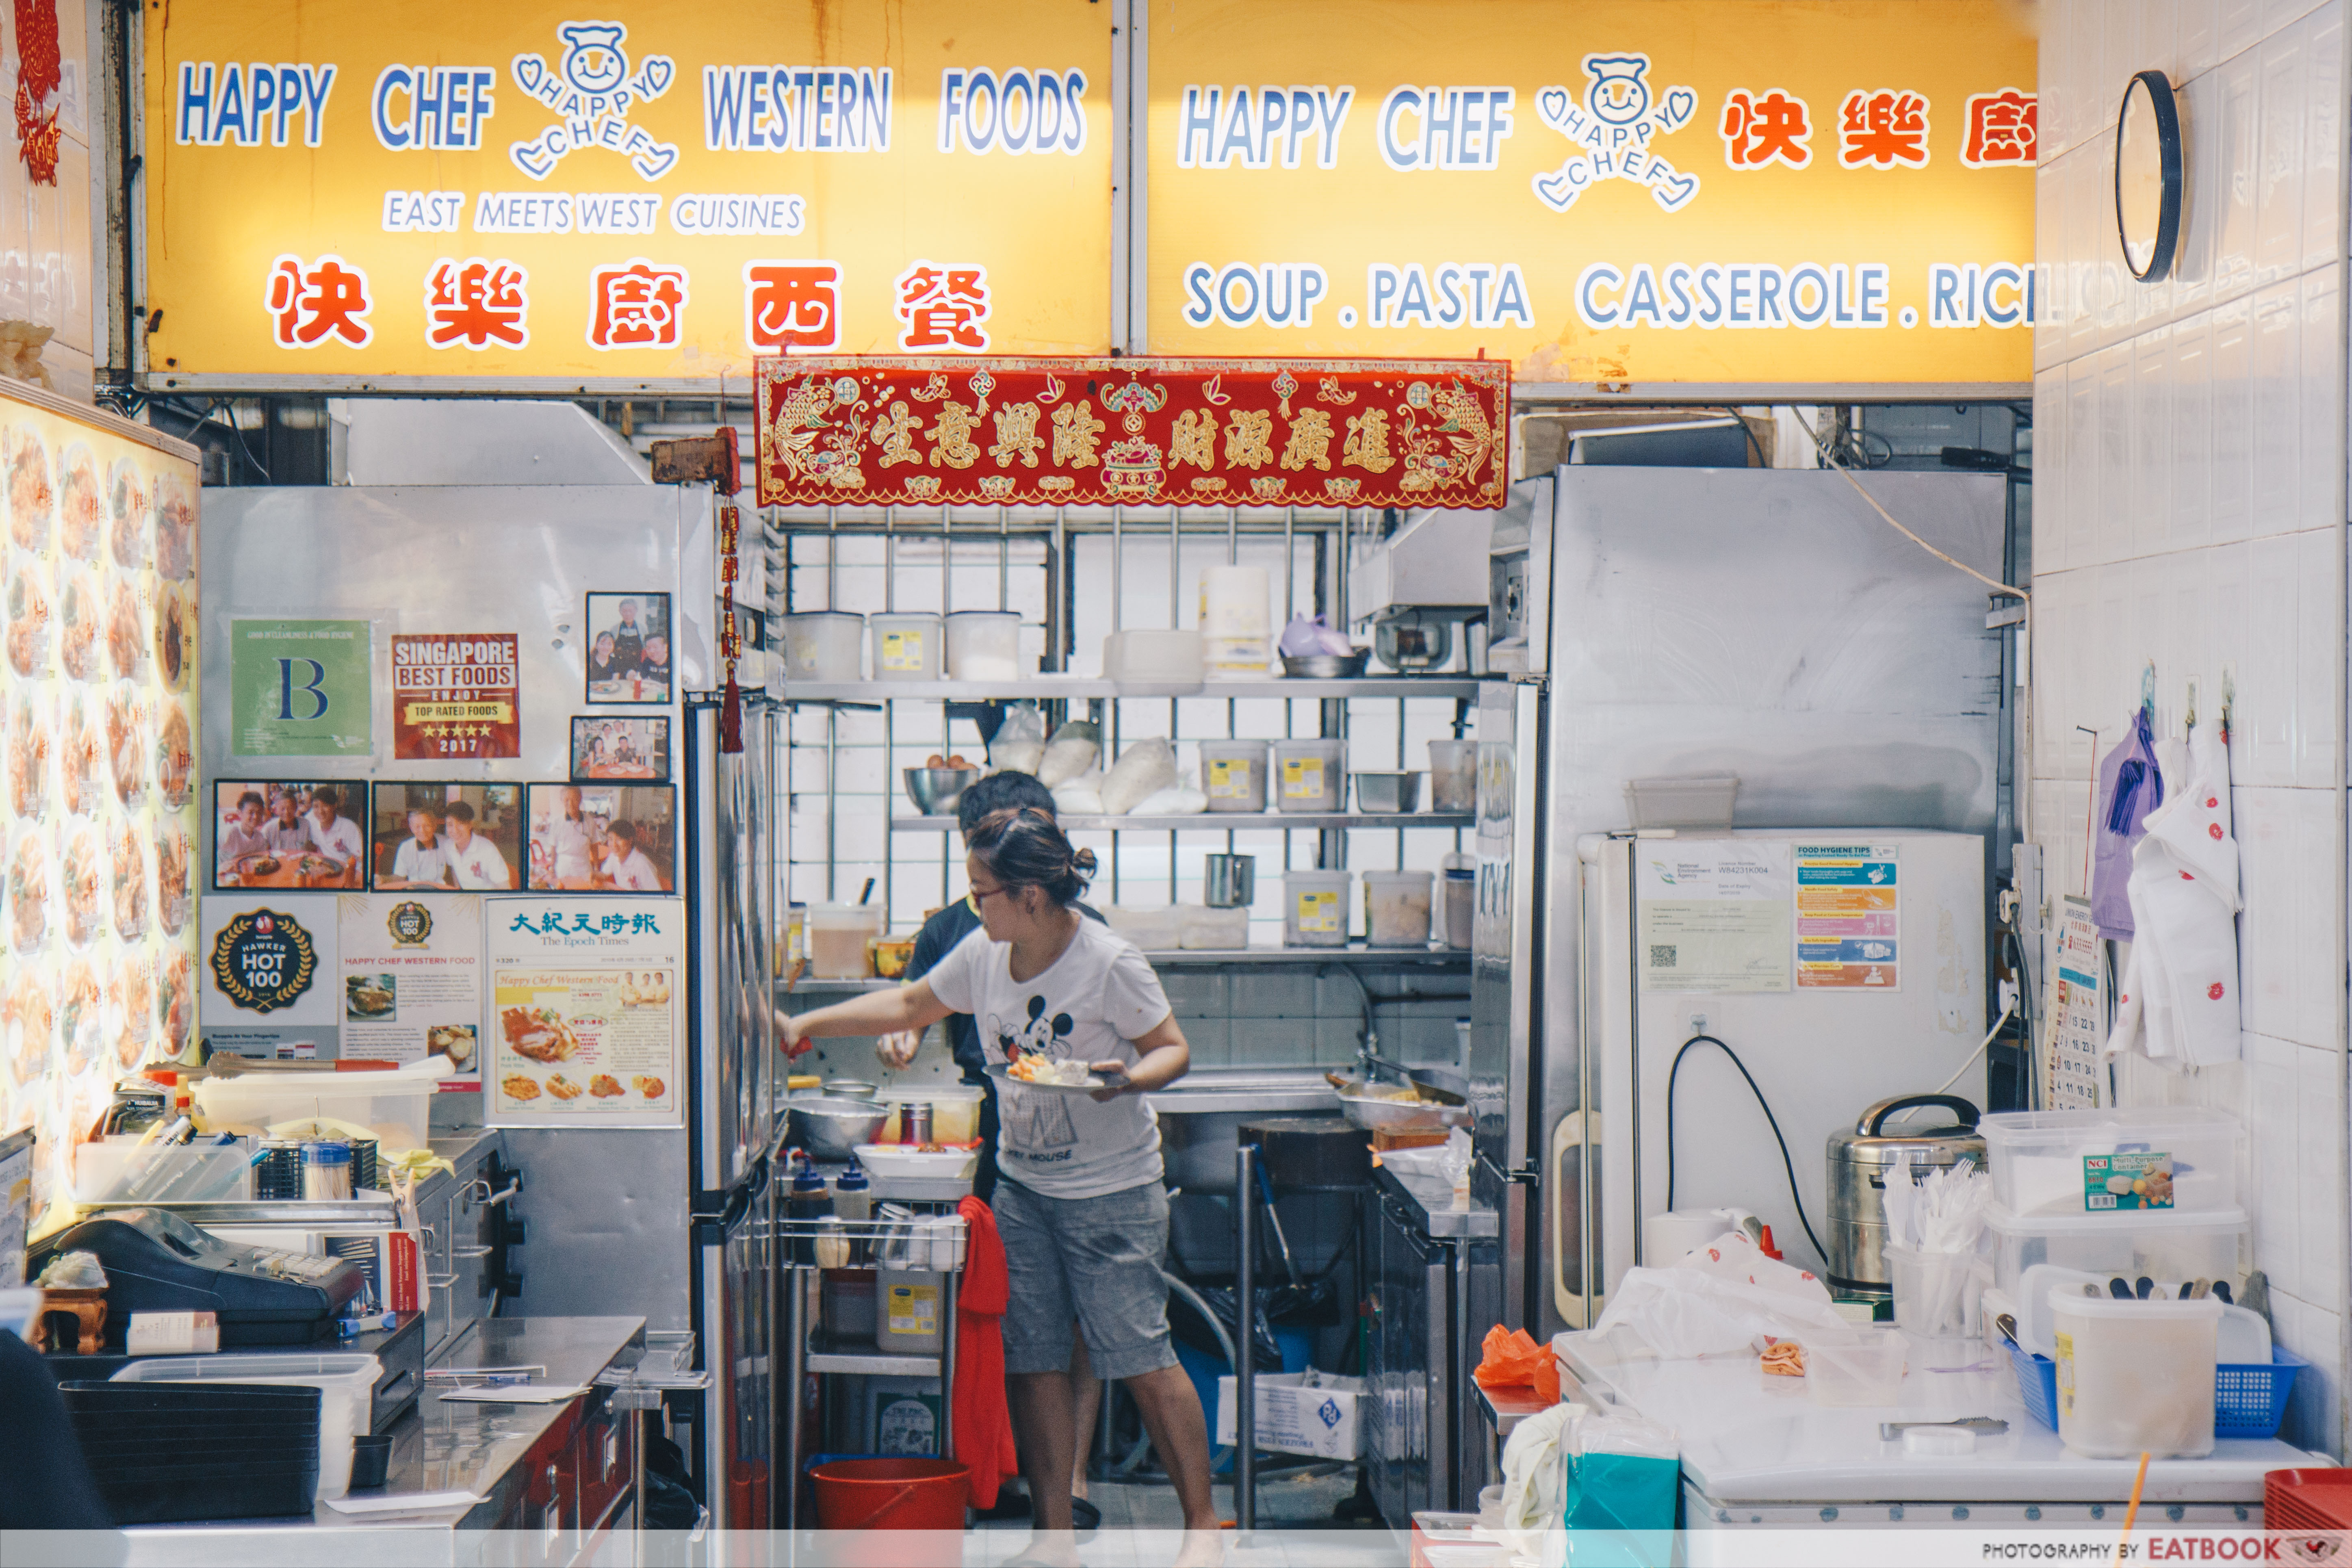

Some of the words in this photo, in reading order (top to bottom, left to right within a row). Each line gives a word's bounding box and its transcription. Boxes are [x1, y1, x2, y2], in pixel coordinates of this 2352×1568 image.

[182, 65, 333, 145] HAPPY
[376, 70, 492, 146] CHEF
[542, 76, 652, 118] HAPPY
[708, 70, 889, 147] WESTERN
[944, 72, 1085, 150] FOODS
[1184, 90, 1351, 163] HAPPY
[1384, 90, 1511, 165] CHEF
[1564, 106, 1672, 148] HAPPY
[545, 119, 646, 154] CHEF
[1567, 150, 1667, 185] CHEF
[387, 197, 461, 227] EAST
[479, 197, 570, 228] MEETS
[581, 198, 658, 228] WEST
[676, 200, 800, 229] CUISINES
[1187, 267, 1322, 322] SOUP
[1375, 269, 1528, 322] PASTA
[1582, 268, 1888, 323] CASSEROLE
[1935, 268, 2035, 323] RIC
[1168, 406, 1397, 474] 財源廣進
[396, 642, 515, 665] SINGAPORE
[399, 668, 445, 686] BEST
[451, 668, 511, 686] FOODS
[274, 657, 329, 720] B
[431, 690, 481, 702] ENJOY
[415, 707, 432, 717] TOP
[435, 707, 463, 717] RATED
[467, 706, 498, 716] FOODS
[440, 740, 477, 752] 2017
[509, 913, 661, 935] 大紀元時報
[241, 942, 286, 952] HAWKER
[541, 937, 561, 946] The
[564, 937, 595, 947] Epoch
[597, 936, 629, 946] Times
[241, 954, 286, 970] HOT
[345, 957, 375, 965] HAPPY
[378, 957, 402, 965] CHEF
[246, 971, 282, 987] 100
[500, 976, 530, 987] Happy
[532, 975, 553, 987] Chef
[556, 975, 594, 985] Western
[596, 975, 620, 984] Food
[2081, 1018, 2088, 1029] 22
[2072, 1039, 2079, 1050] 16
[2082, 1041, 2090, 1052] 23
[2064, 1060, 2071, 1071] 10
[2075, 1062, 2081, 1073] 17
[2085, 1064, 2091, 1075] 24
[2066, 1082, 2073, 1093] 11
[2077, 1084, 2084, 1096] 18
[2087, 1087, 2093, 1099] 25
